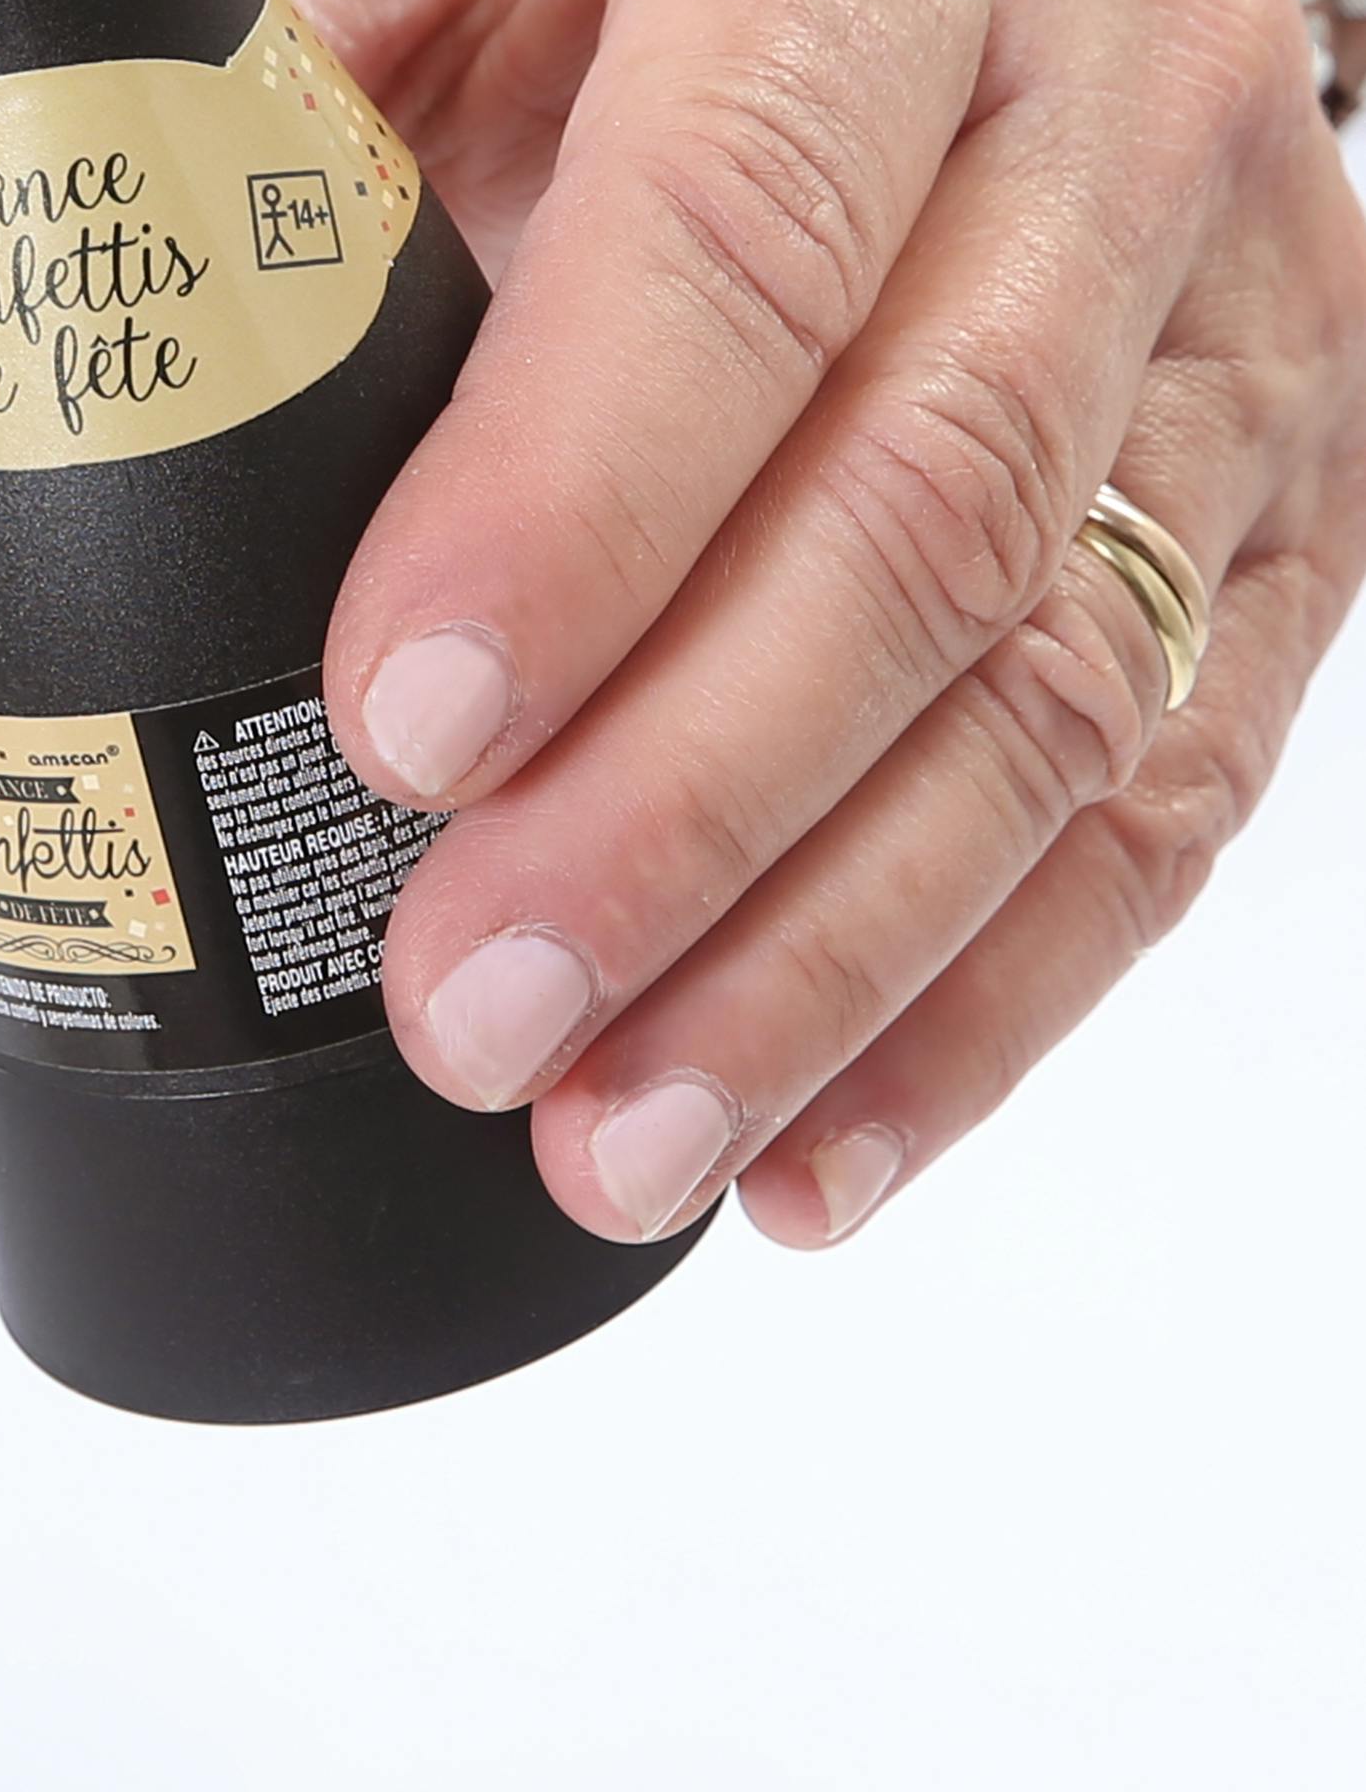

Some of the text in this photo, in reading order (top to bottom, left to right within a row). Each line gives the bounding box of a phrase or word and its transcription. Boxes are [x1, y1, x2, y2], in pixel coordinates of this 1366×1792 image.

[286, 198, 330, 230] 14+
[54, 316, 198, 436] fête
[196, 753, 218, 772] des
[218, 743, 264, 767] sources
[265, 728, 311, 755] directes
[311, 722, 327, 741] de
[200, 769, 228, 792] Ceci
[228, 764, 258, 785] n'est
[258, 759, 280, 782] pas
[281, 754, 297, 771] un
[206, 781, 267, 811] seulement
[328, 758, 348, 780] par
[212, 812, 234, 834] pas
[234, 808, 248, 825] le
[248, 800, 281, 821] lance
[281, 783, 330, 813] confettis
[330, 776, 355, 796] vers
[216, 829, 235, 849] Ne
[294, 810, 316, 833] pas
[316, 804, 329, 822] le
[329, 795, 361, 817] lance
[223, 838, 304, 877] HAUTEUR
[304, 812, 382, 856] REQUISE:
[229, 877, 248, 896] Ne
[248, 873, 270, 895] pas
[271, 863, 311, 886] utiliser
[313, 853, 339, 877] près
[339, 847, 361, 865] des
[392, 826, 413, 845] des
[235, 896, 252, 915] du
[252, 886, 300, 911] mobilier
[301, 880, 321, 898] car
[321, 873, 340, 892] les
[341, 856, 388, 886] confettis
[282, 898, 325, 928] produit
[325, 887, 357, 912] après
[10, 901, 35, 921] DE
[316, 914, 336, 936] est
[250, 951, 282, 972] toute
[257, 960, 324, 995] PRODUIT
[326, 948, 367, 978] AVEC
[30, 980, 47, 1003] DE
[45, 984, 112, 1008] PRODUCTO:
[300, 986, 322, 1006] des
[322, 970, 371, 1000] confettis
[103, 1012, 118, 1030] de
[118, 1011, 162, 1030] colores.
